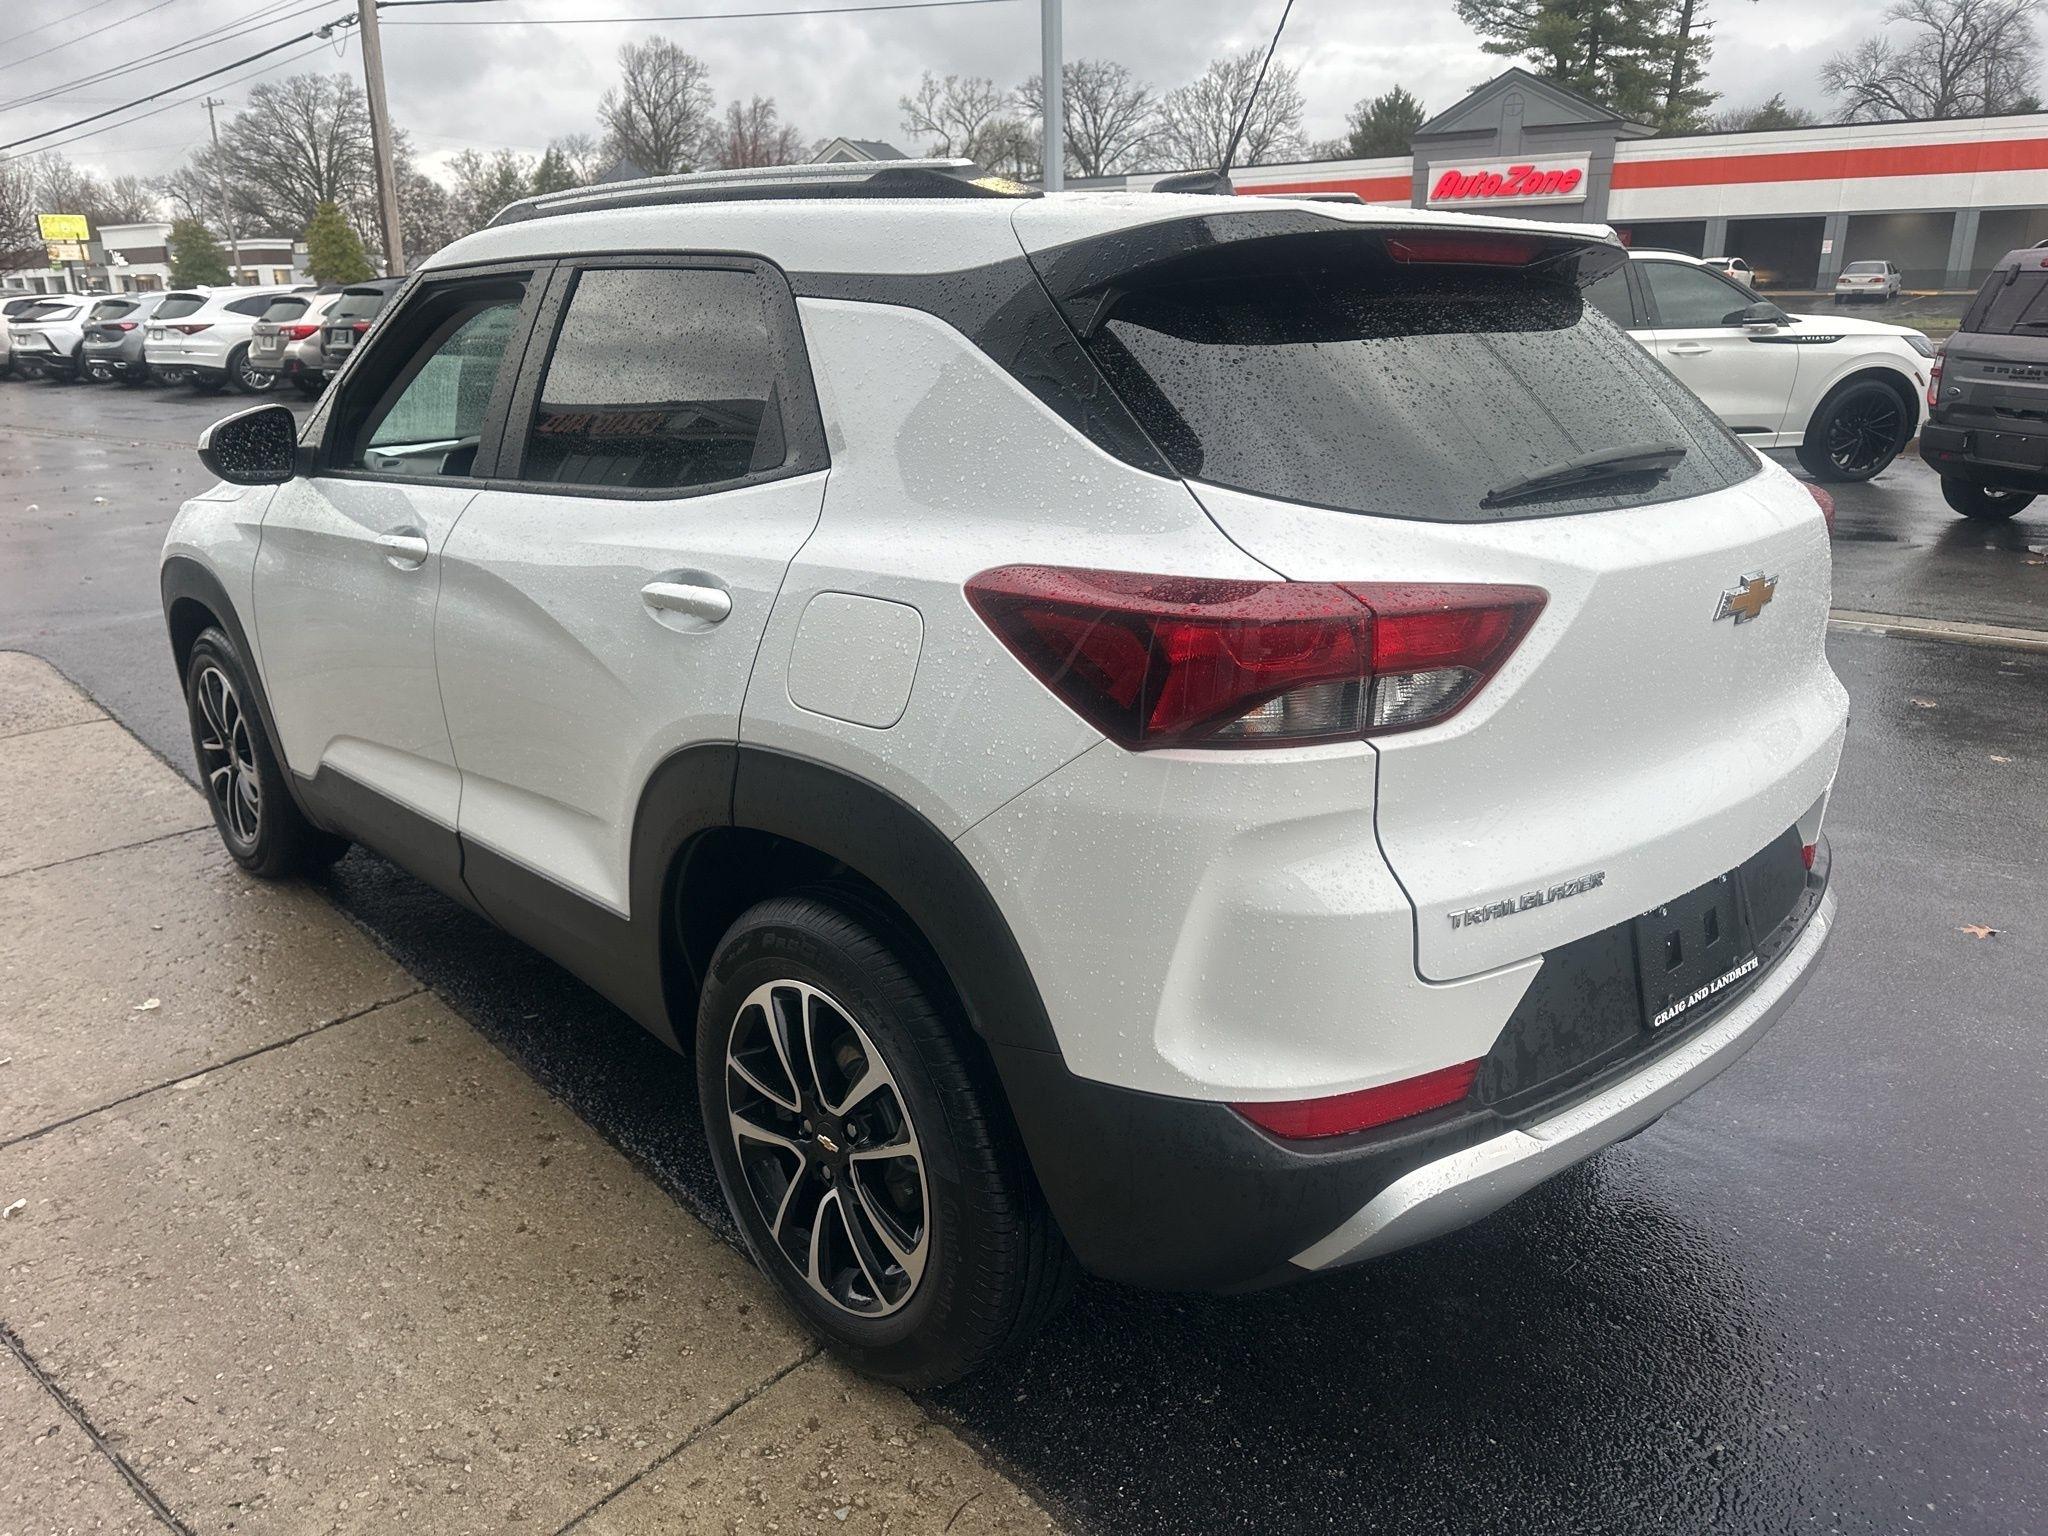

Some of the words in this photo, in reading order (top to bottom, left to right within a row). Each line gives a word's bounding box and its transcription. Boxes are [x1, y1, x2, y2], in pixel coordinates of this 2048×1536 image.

[1430, 165, 1583, 200] AutoZone
[1447, 871, 1605, 929] TRAILBLAZER
[1654, 1000, 1686, 1027] CRAIG
[1687, 986, 1709, 1008] AND
[1710, 957, 1759, 994] LANDRETH
